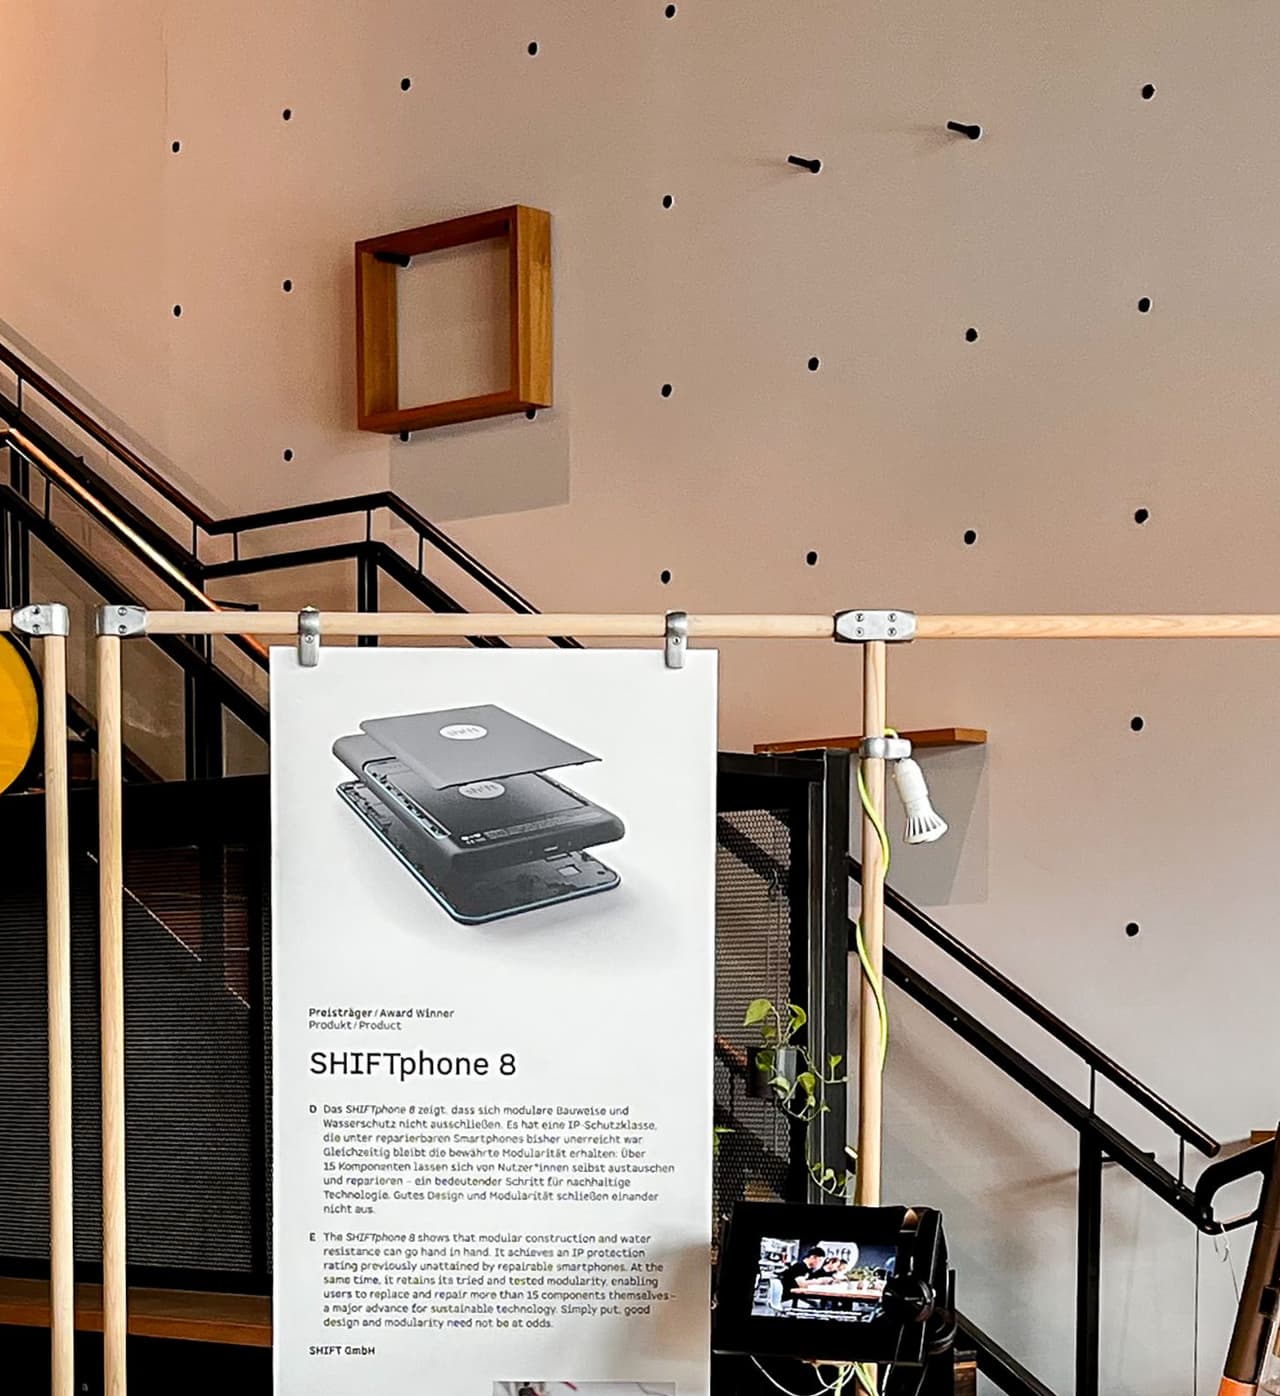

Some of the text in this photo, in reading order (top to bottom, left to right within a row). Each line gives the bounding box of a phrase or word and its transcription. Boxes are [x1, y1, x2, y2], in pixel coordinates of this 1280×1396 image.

[379, 1007, 413, 1018] Award
[415, 1007, 454, 1018] Winner
[308, 1019, 352, 1030] Produkt
[358, 1020, 401, 1031] Product
[310, 1050, 515, 1081] SHIFTphone 8
[309, 1232, 316, 1242] E
[323, 1232, 343, 1243] The
[408, 1232, 415, 1243] 8
[417, 1232, 450, 1243] shows
[452, 1232, 475, 1243] that
[478, 1232, 522, 1243] modular
[598, 1233, 617, 1244] and
[619, 1233, 651, 1244] water
[383, 1248, 402, 1257] can
[404, 1249, 418, 1260] go
[420, 1246, 446, 1257] hand
[449, 1246, 460, 1257] in
[494, 1247, 505, 1257] It
[507, 1247, 553, 1257] achieves
[556, 1249, 569, 1258] an
[571, 1247, 584, 1258] IP
[323, 1317, 359, 1330] design
[362, 1317, 381, 1328] and
[446, 1317, 472, 1328] need
[475, 1317, 493, 1328] not
[495, 1318, 509, 1328] be
[511, 1318, 523, 1328] at
[309, 1345, 375, 1356] SHIFT GmbH
